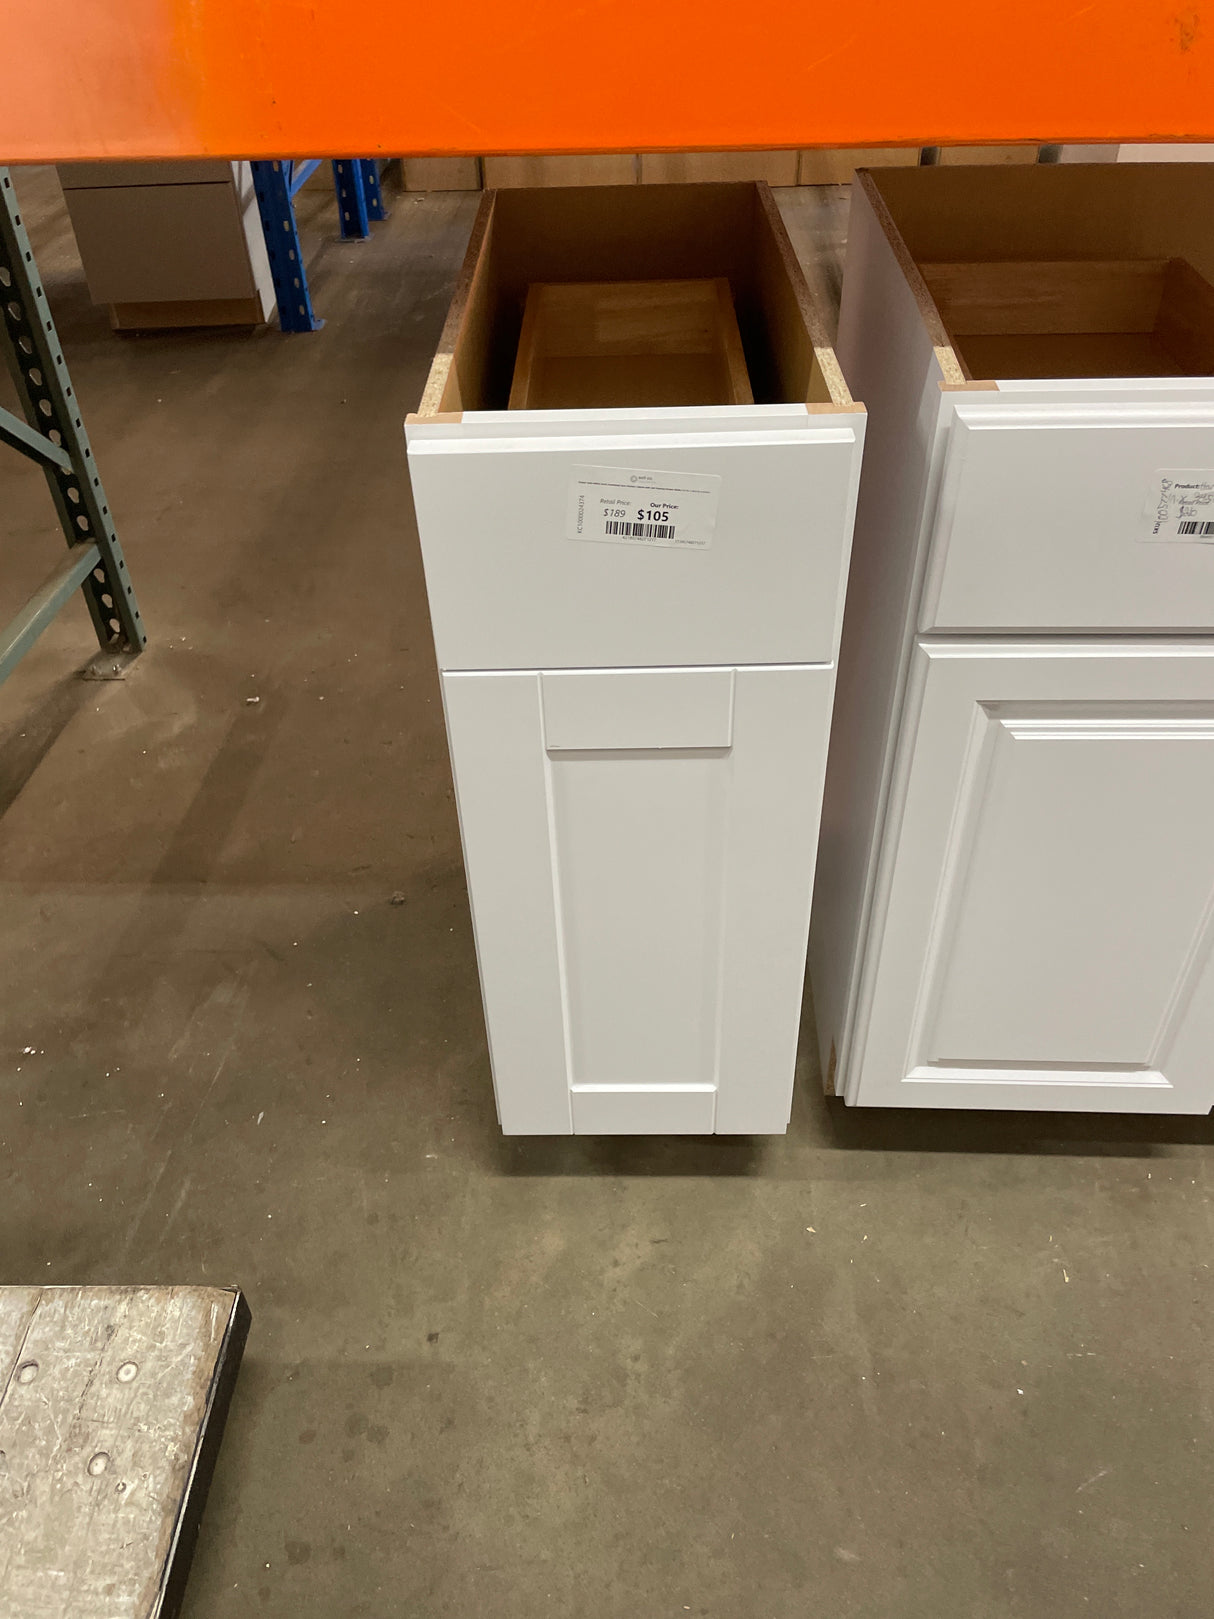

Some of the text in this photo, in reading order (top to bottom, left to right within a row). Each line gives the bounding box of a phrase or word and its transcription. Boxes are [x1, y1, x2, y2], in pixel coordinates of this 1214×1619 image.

[600, 498, 616, 506] Retail
[603, 508, 626, 518] $189
[637, 508, 669, 522] $105
